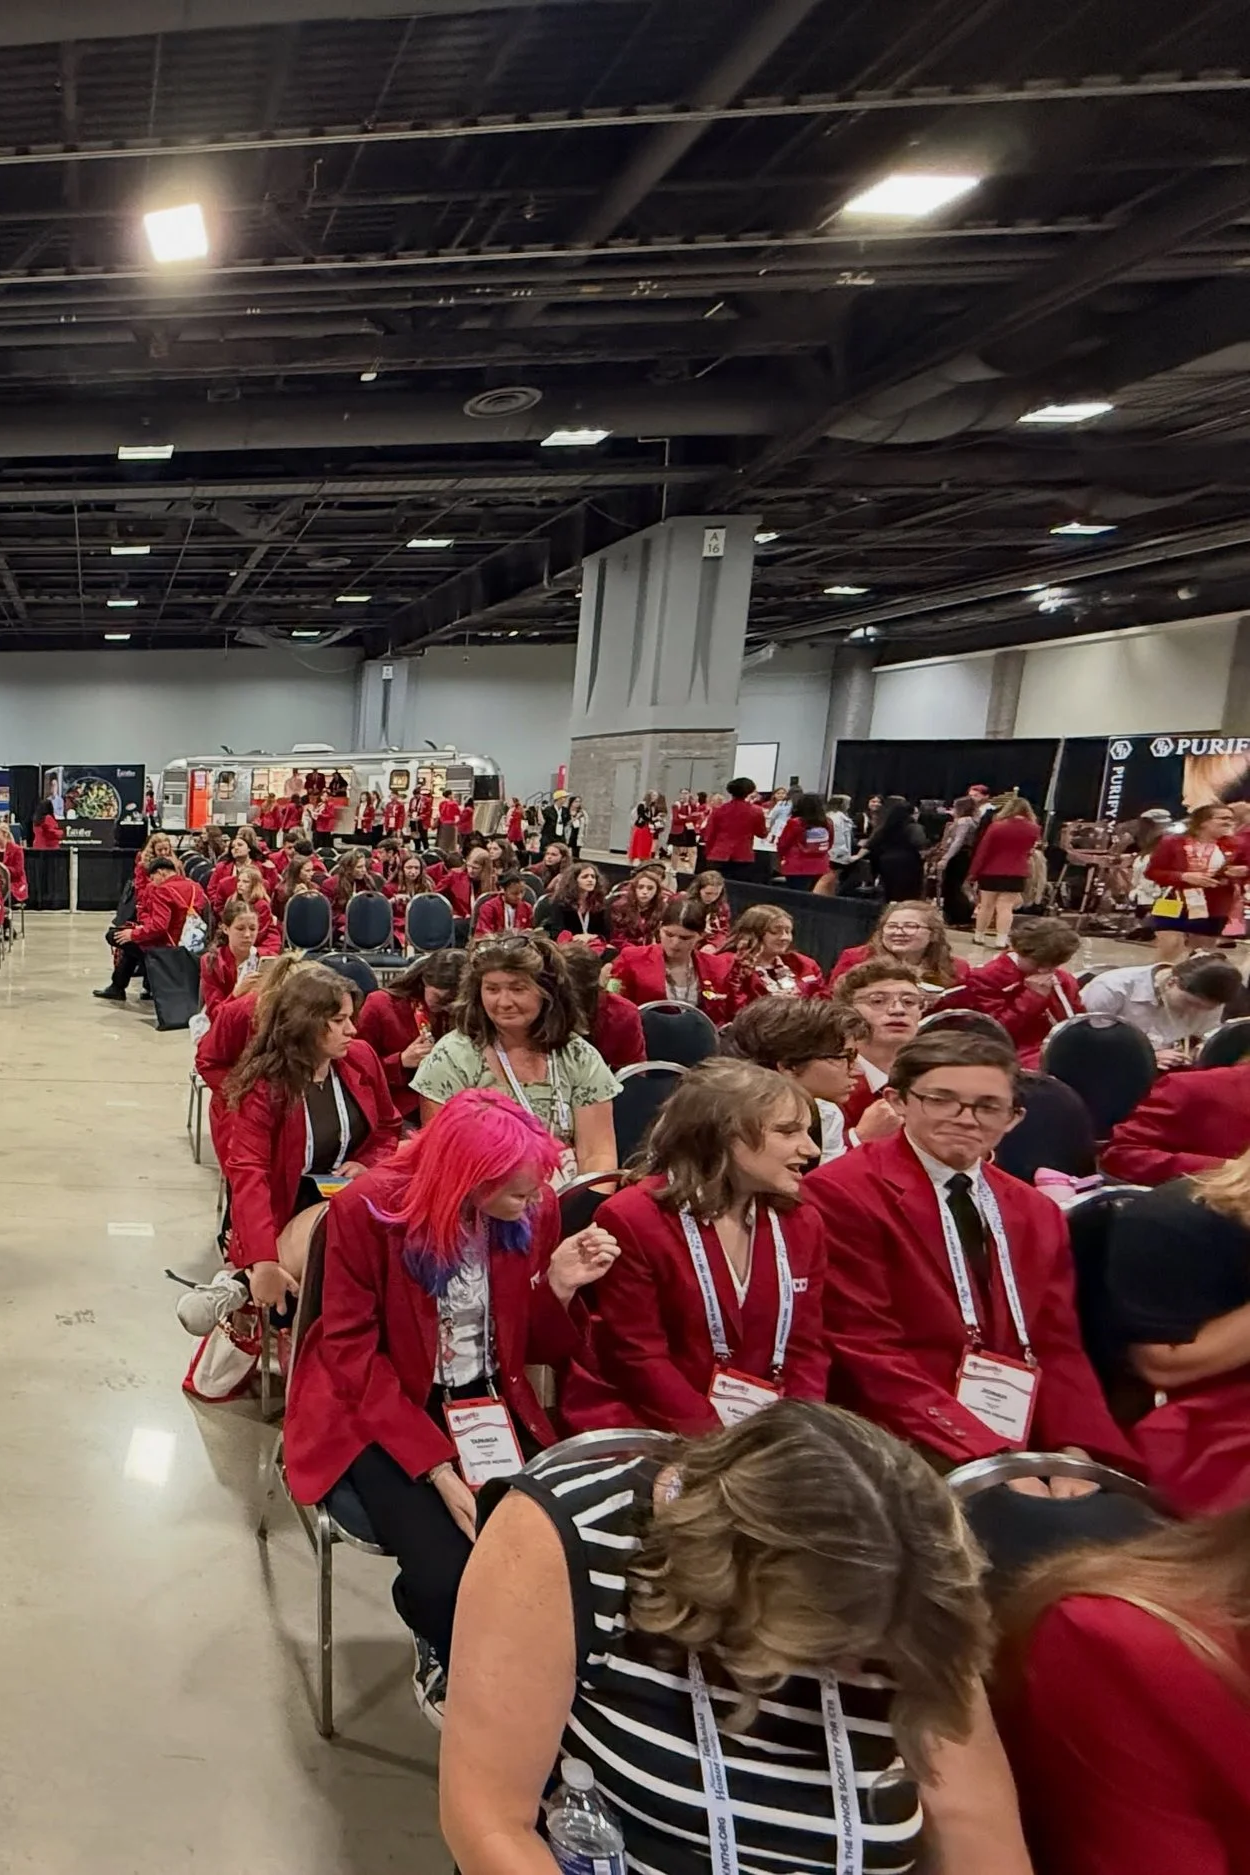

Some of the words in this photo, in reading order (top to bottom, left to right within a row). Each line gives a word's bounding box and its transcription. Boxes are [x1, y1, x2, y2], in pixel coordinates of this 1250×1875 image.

[708, 543, 720, 553] 16
[710, 532, 718, 541] A
[1105, 765, 1125, 817] PURIFY
[697, 1713, 710, 1757] Technical
[829, 1722, 839, 1744] FOR
[714, 1762, 726, 1800] Honor
[834, 1747, 847, 1792] SOCIETY
[841, 1795, 853, 1836] HONOR
[844, 1839, 854, 1864] THE
